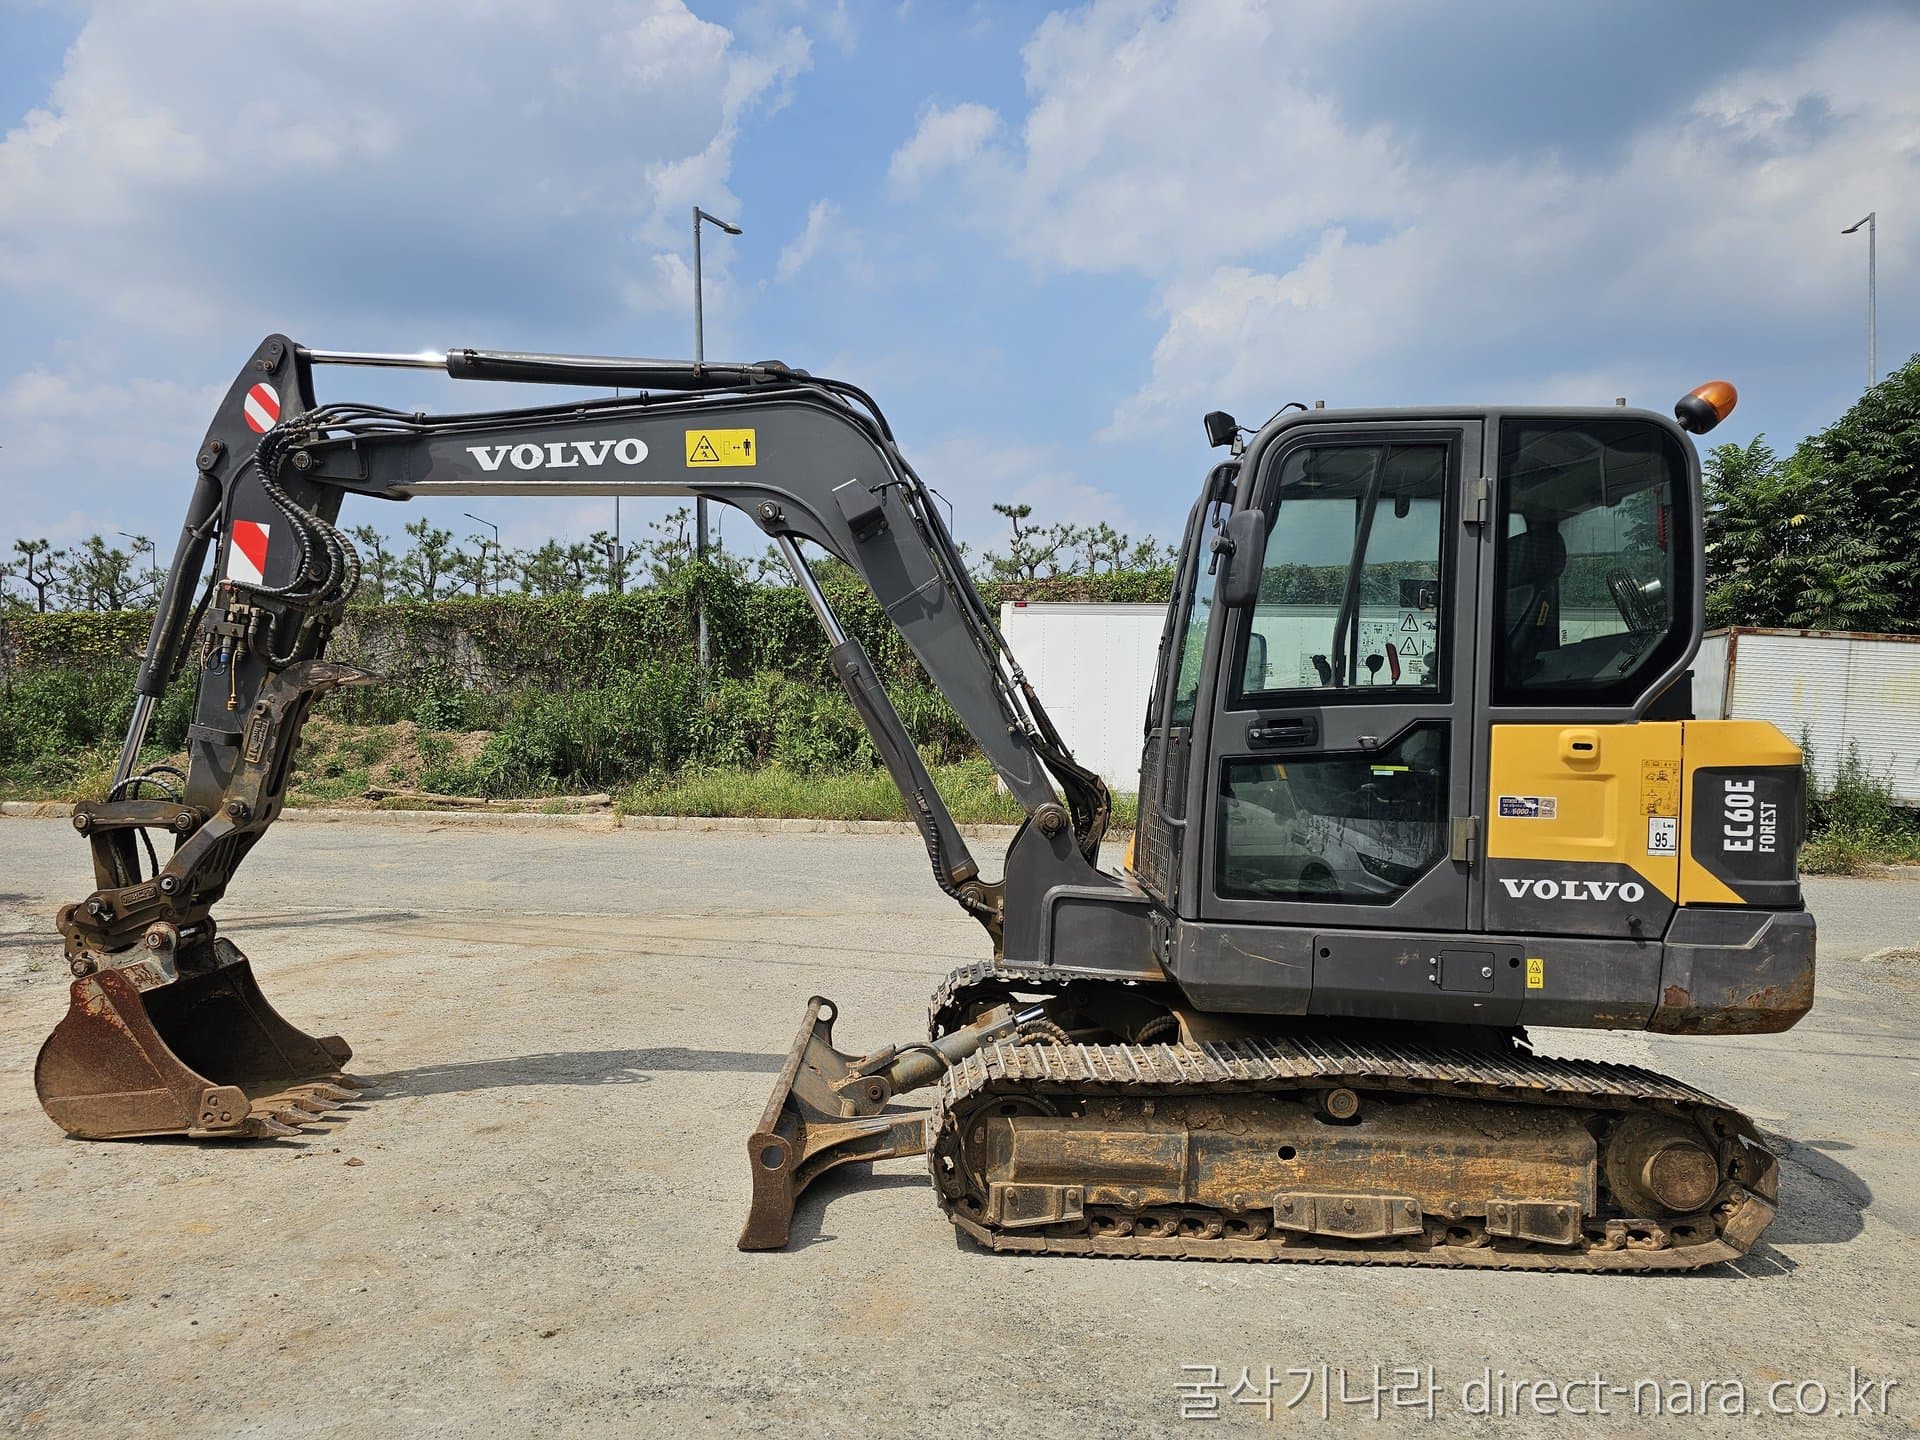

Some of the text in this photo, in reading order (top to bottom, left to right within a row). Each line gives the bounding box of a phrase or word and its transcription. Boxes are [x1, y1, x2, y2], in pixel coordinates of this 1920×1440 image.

[466, 438, 649, 471] VOLVO
[1723, 780, 1755, 851] EC60E
[1759, 801, 1777, 852] FOREST
[1655, 832, 1668, 847] 95
[1499, 879, 1645, 902] VOLVO
